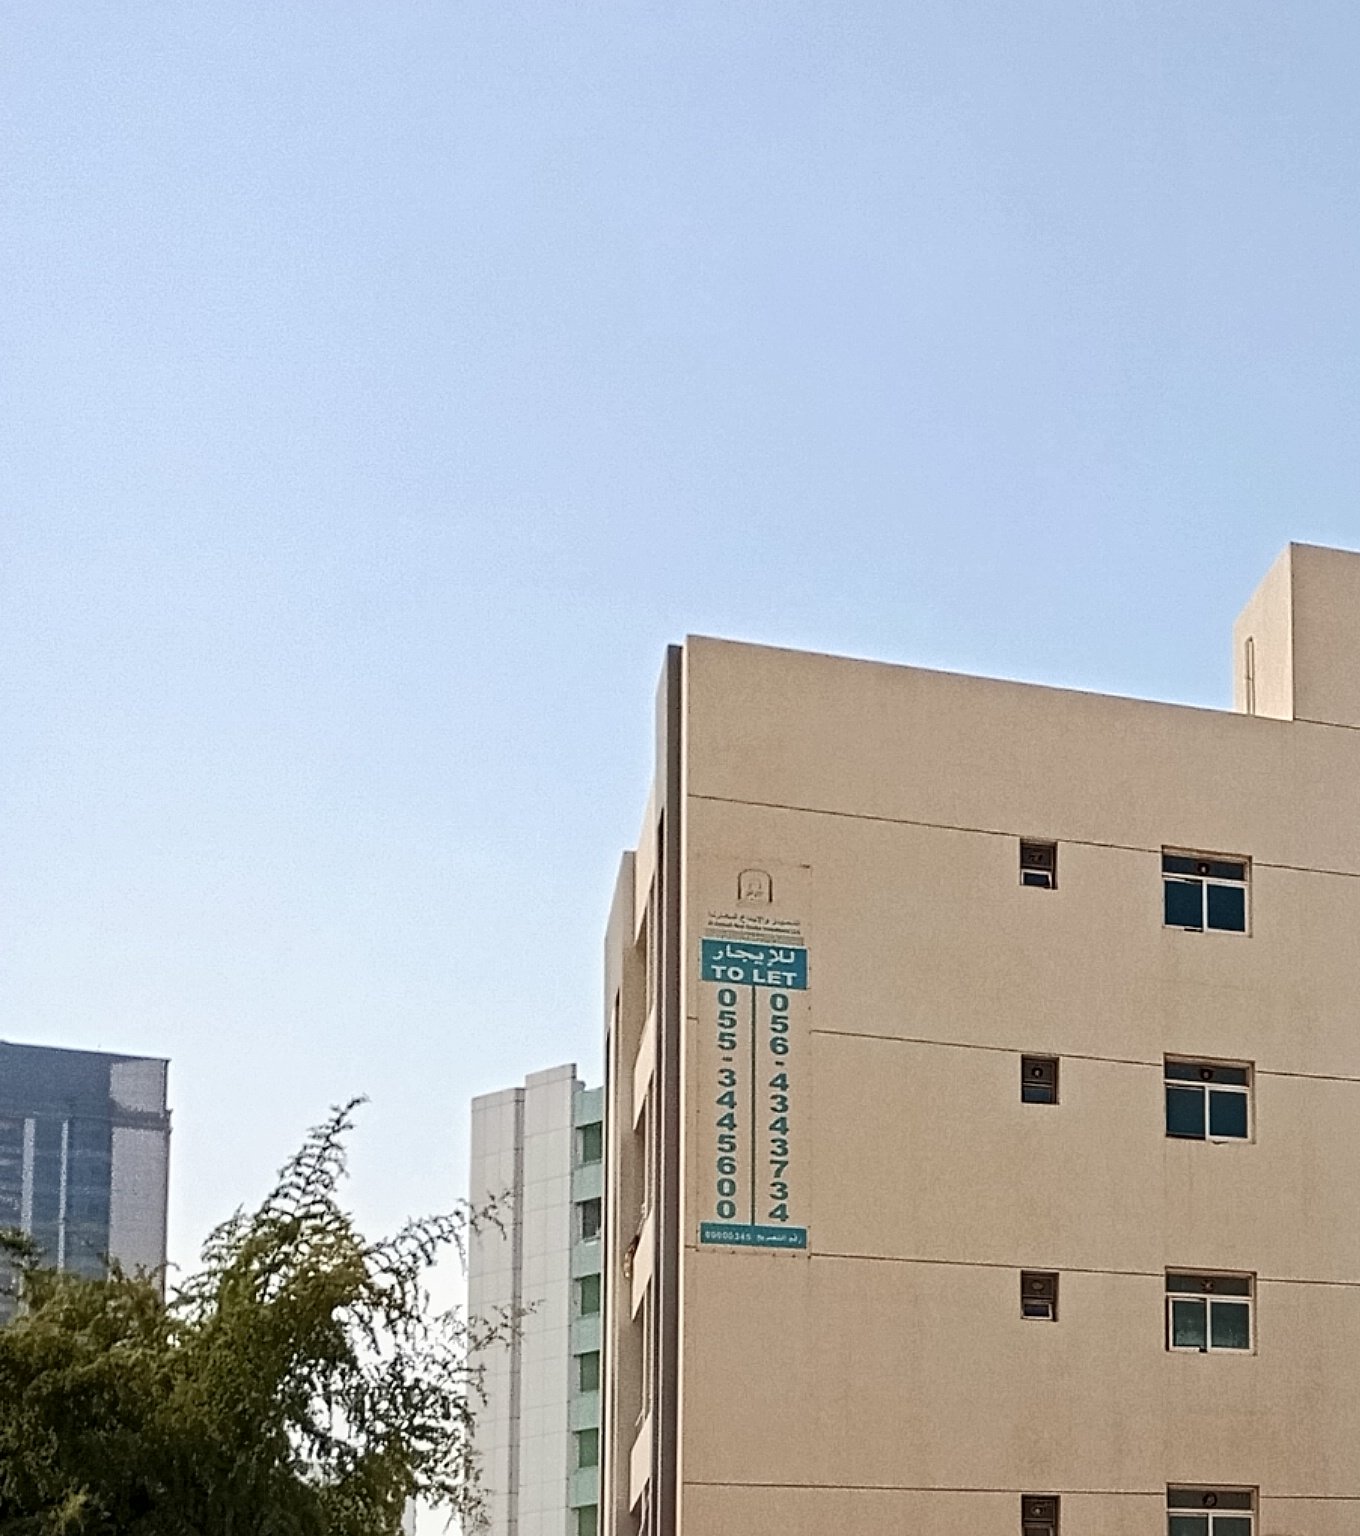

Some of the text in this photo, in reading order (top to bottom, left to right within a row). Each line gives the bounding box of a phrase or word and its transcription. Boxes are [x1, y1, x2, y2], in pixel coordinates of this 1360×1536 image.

[712, 944, 795, 966] للإيجار
[711, 964, 797, 986] TO LET
